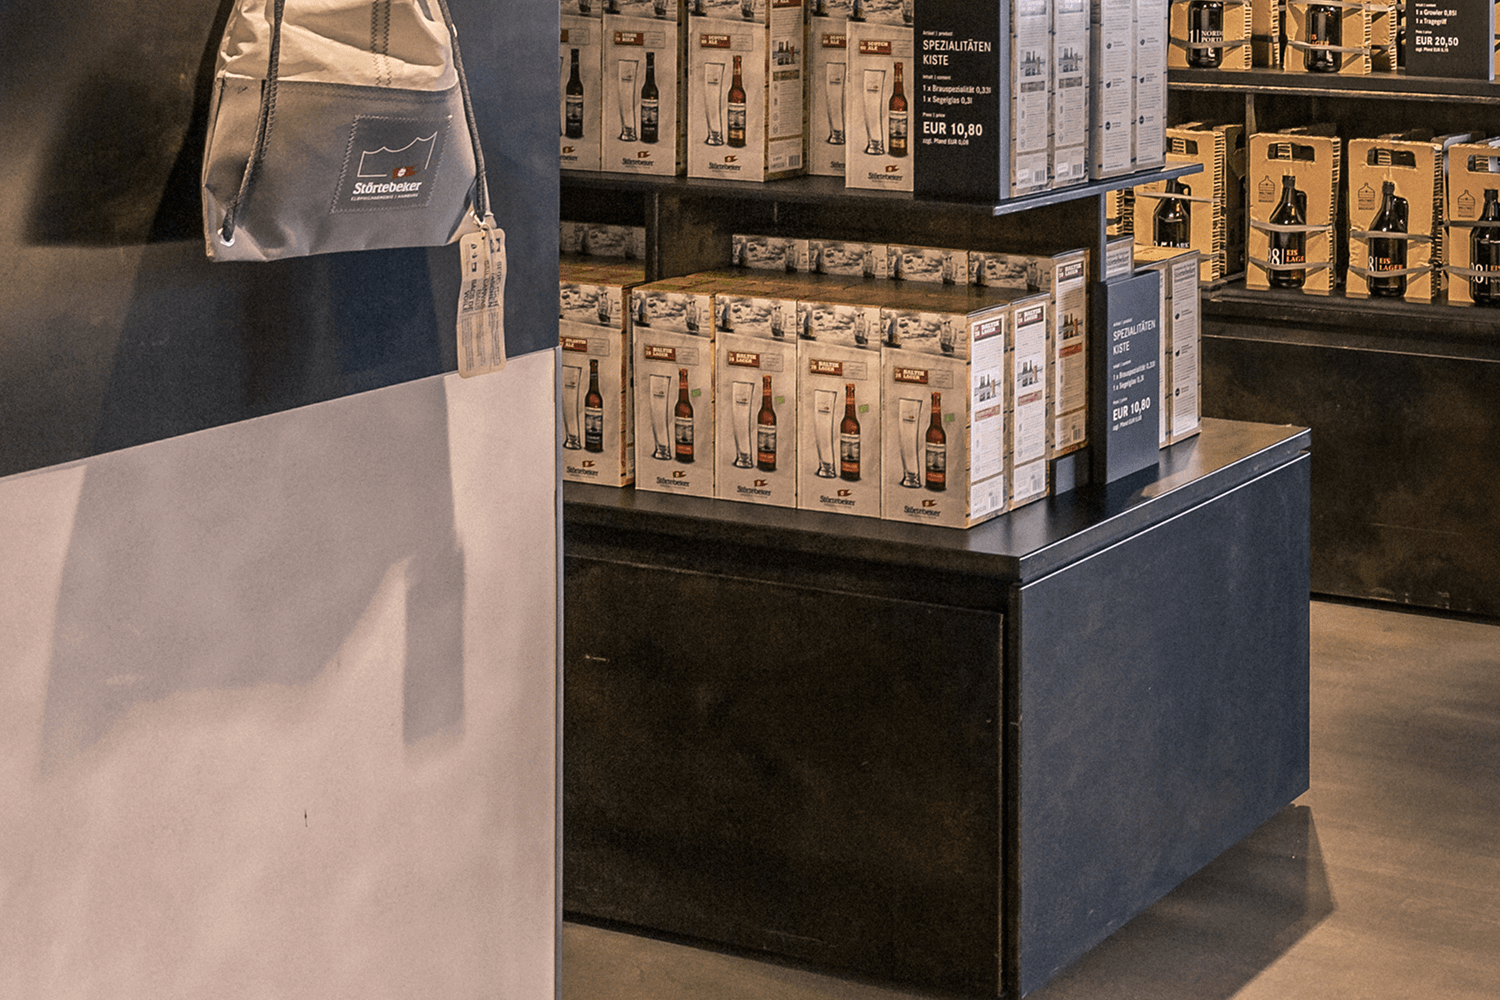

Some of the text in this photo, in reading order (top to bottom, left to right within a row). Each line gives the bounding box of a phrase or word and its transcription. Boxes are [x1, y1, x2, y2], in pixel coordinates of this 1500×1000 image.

[923, 39, 991, 52] SPEZIALITÄTEN
[1416, 36, 1459, 48] EUR 20,50
[923, 55, 949, 66] KISTE
[923, 121, 983, 139] EUR 10,80
[353, 182, 422, 195] Störtebeker
[1113, 319, 1156, 341] SPEZIALITÄTEN
[1113, 341, 1130, 355] KISTE
[1113, 405, 1129, 421] EUR
[1131, 397, 1150, 415] 10,80
